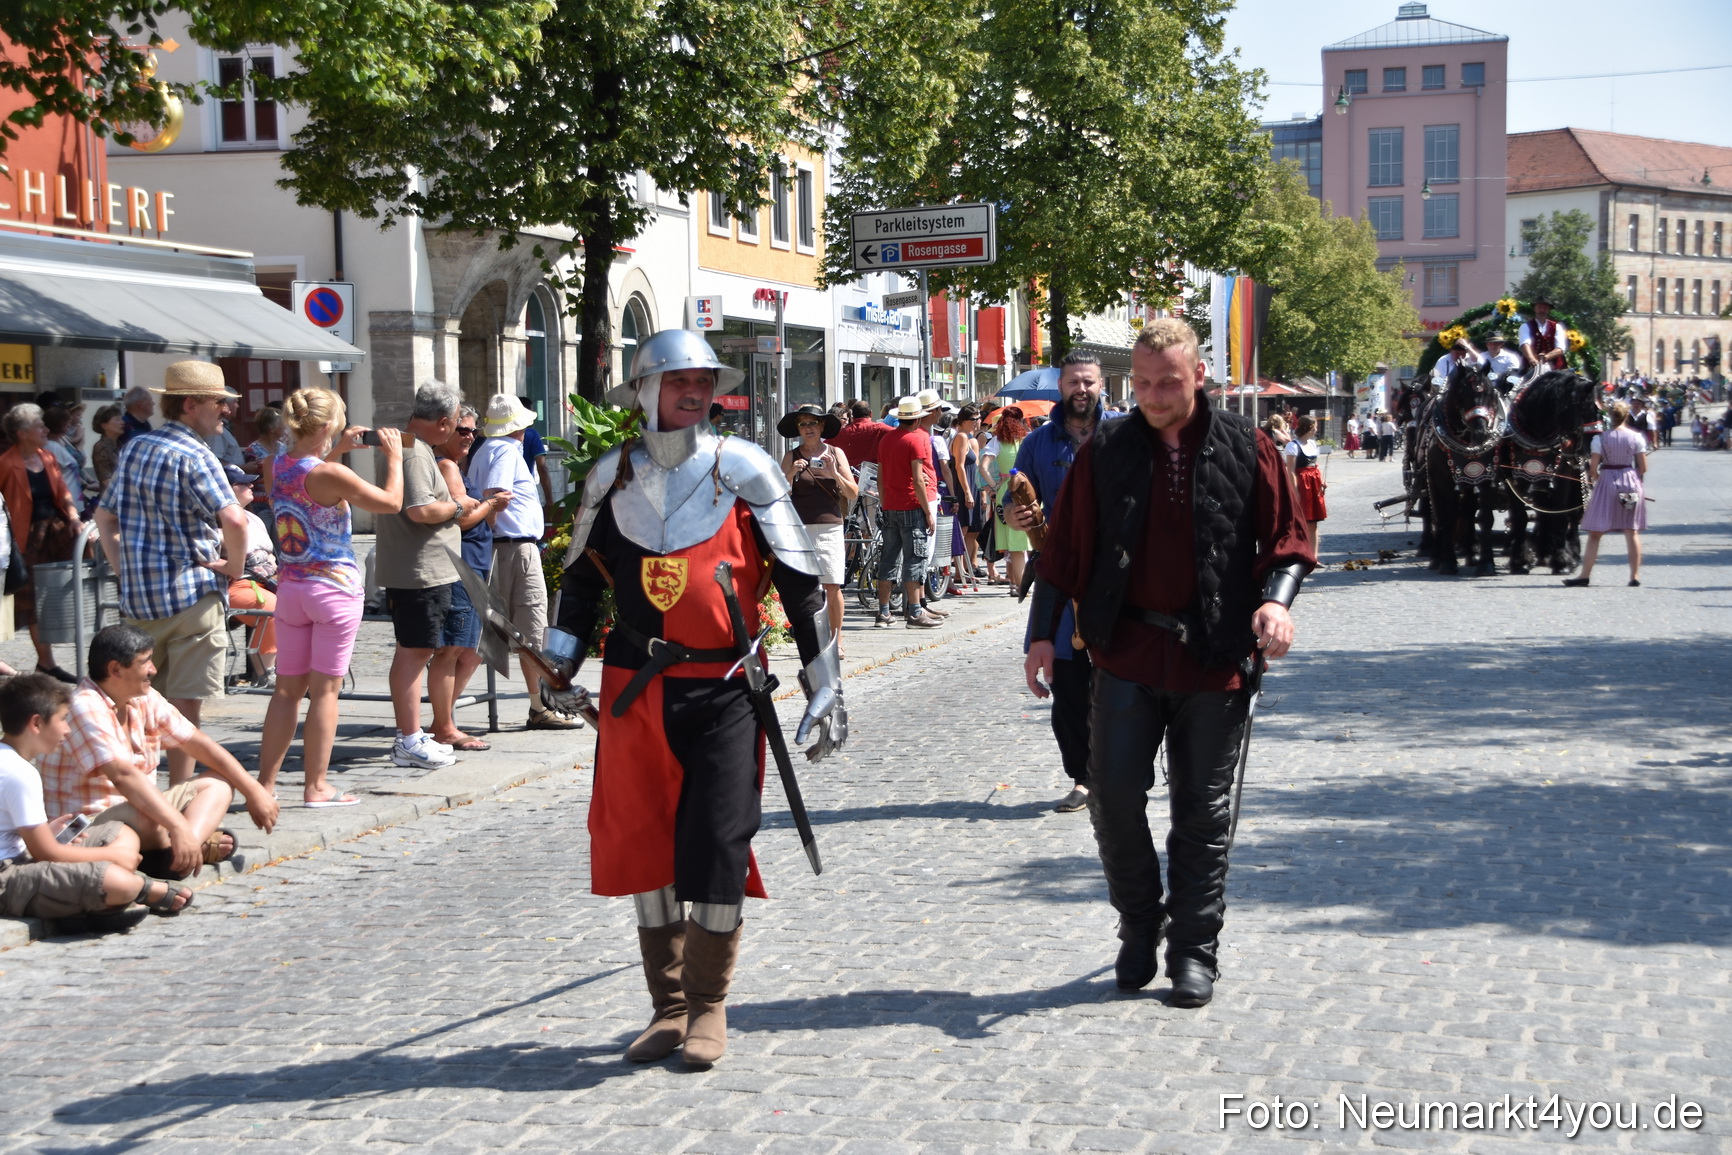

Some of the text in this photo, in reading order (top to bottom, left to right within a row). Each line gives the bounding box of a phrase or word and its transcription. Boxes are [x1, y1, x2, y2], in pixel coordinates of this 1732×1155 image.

[875, 214, 965, 234] Parkleitsystem
[886, 244, 967, 262] P Rosengasse
[885, 294, 918, 307] Rosengasse
